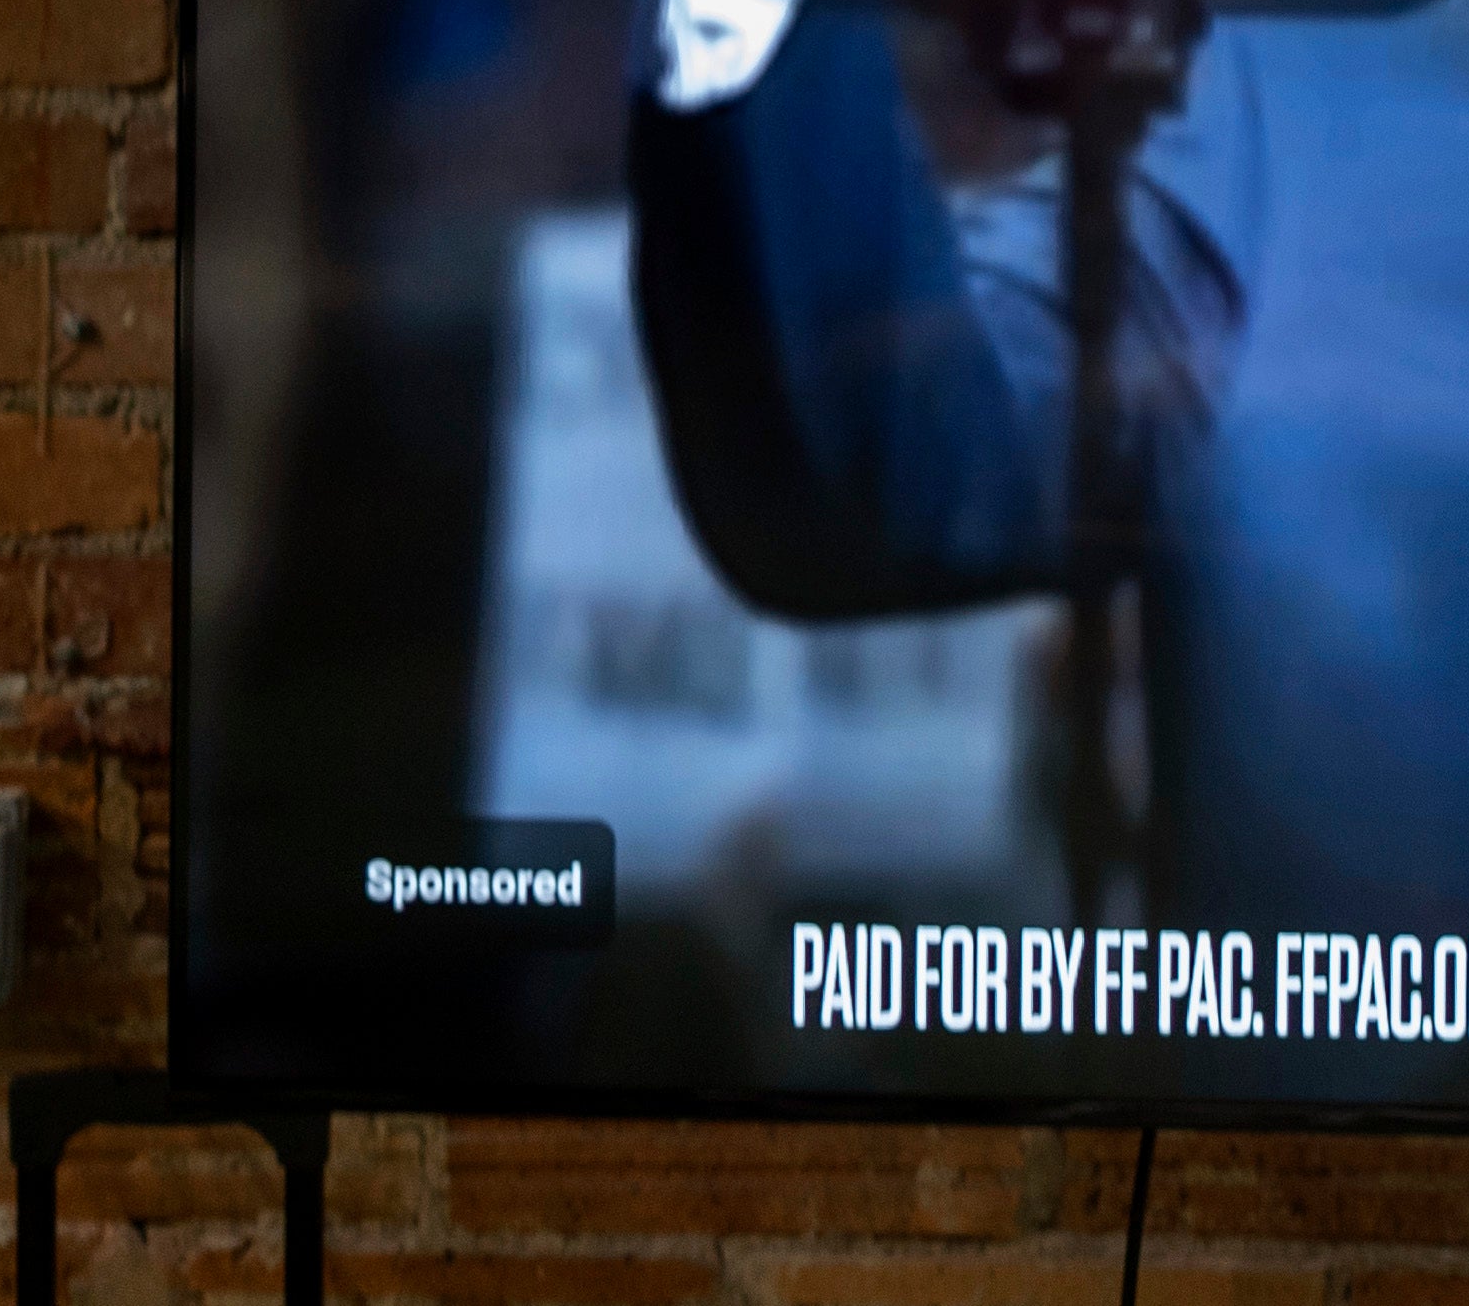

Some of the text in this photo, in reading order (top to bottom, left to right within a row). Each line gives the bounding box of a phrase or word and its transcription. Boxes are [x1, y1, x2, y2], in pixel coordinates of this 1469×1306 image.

[365, 857, 583, 911] Sponsored
[792, 922, 904, 1030] PAID
[914, 924, 1009, 1033] FOR
[1019, 927, 1086, 1034] BY
[1093, 928, 1149, 1035] FF
[1157, 929, 1266, 1037] PAC.
